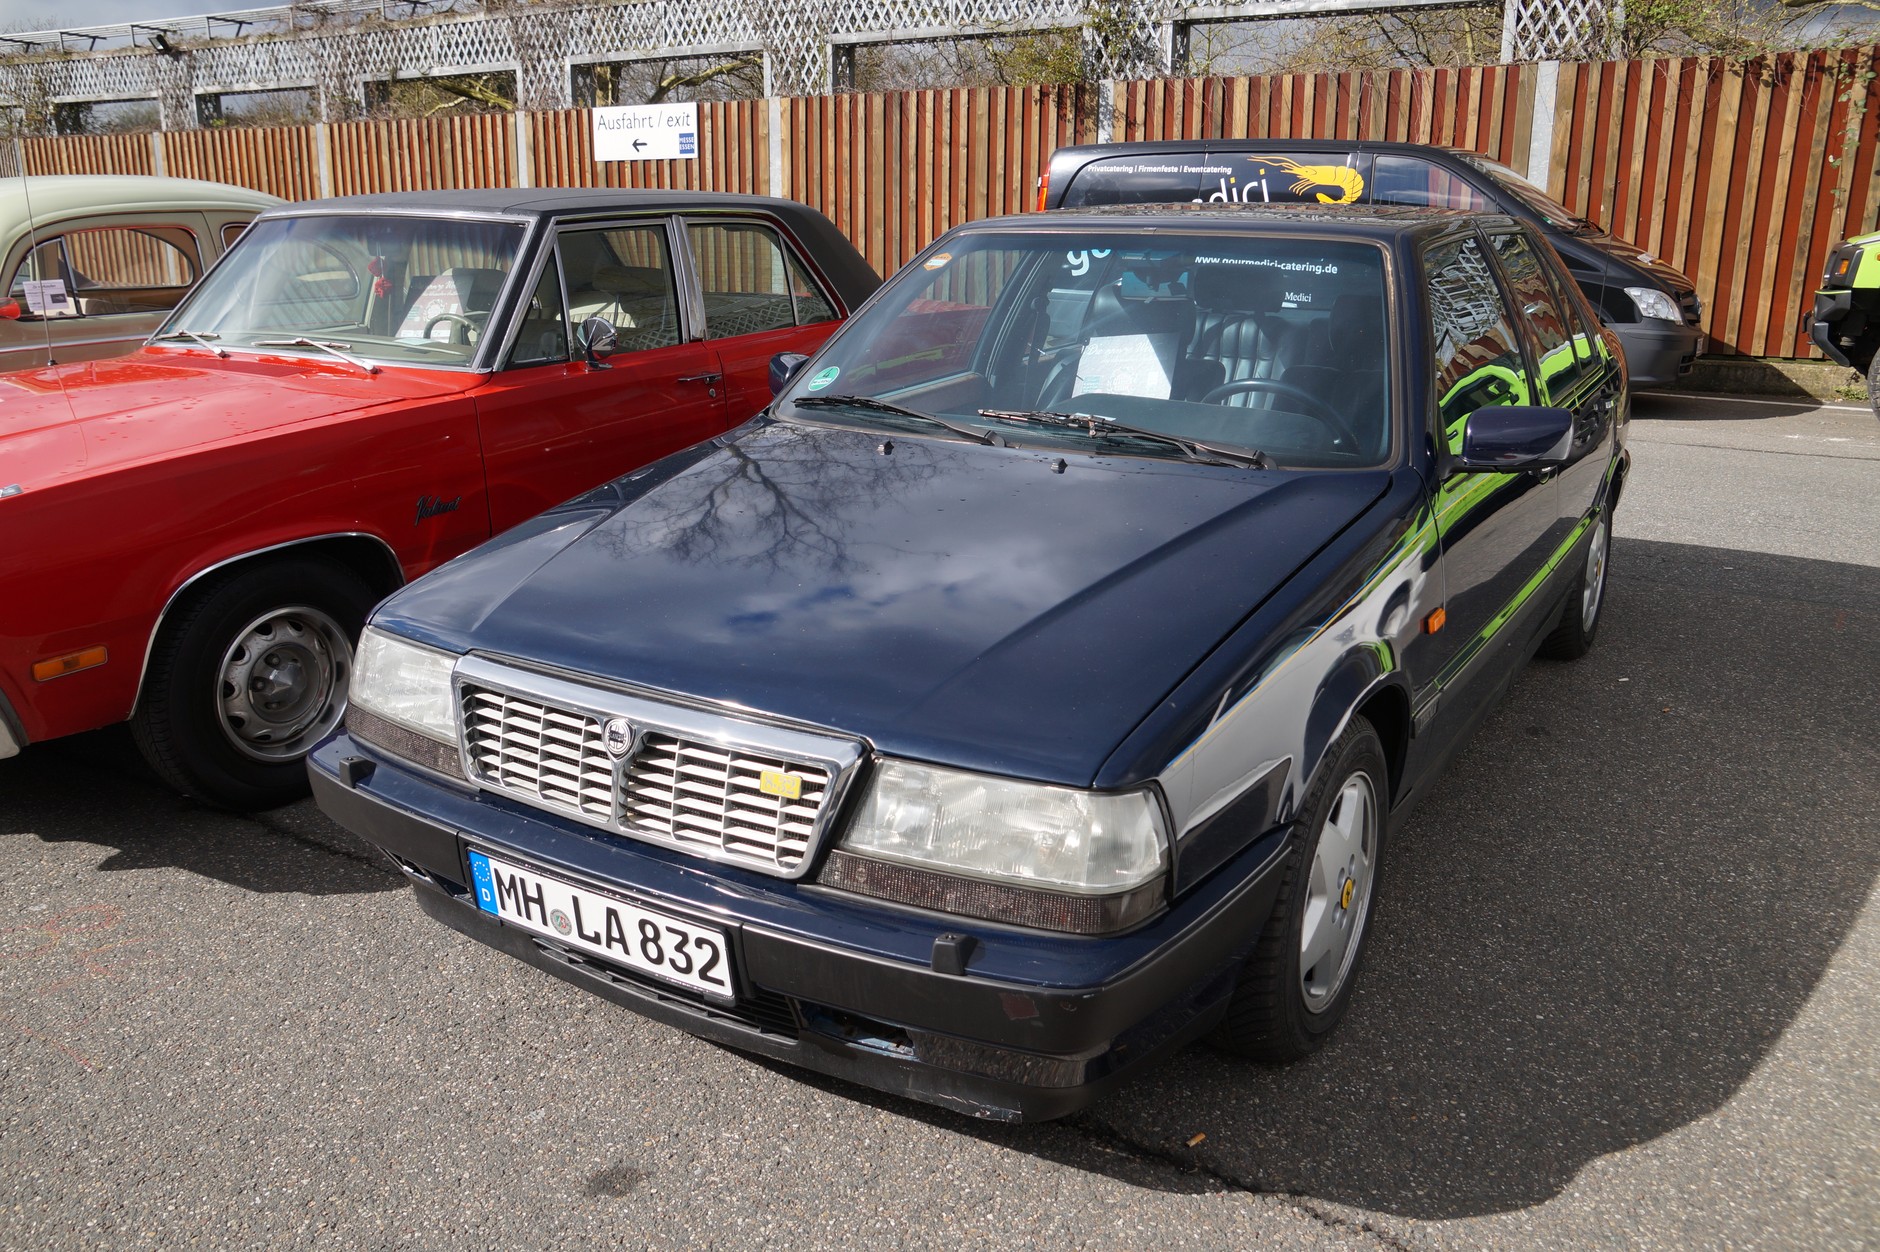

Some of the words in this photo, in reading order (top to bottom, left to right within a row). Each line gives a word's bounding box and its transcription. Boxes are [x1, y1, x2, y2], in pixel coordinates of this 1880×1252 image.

[597, 112, 653, 131] Ausfahrt
[666, 112, 690, 127] exit
[1087, 165, 1134, 174] Privatcatering
[1138, 165, 1179, 173] Firmenfeste
[1183, 165, 1232, 175] Eventcatering
[1284, 292, 1312, 302] Medici
[481, 887, 491, 902] D
[493, 867, 549, 927] MH
[571, 895, 631, 956] LA
[637, 918, 725, 987] 832
